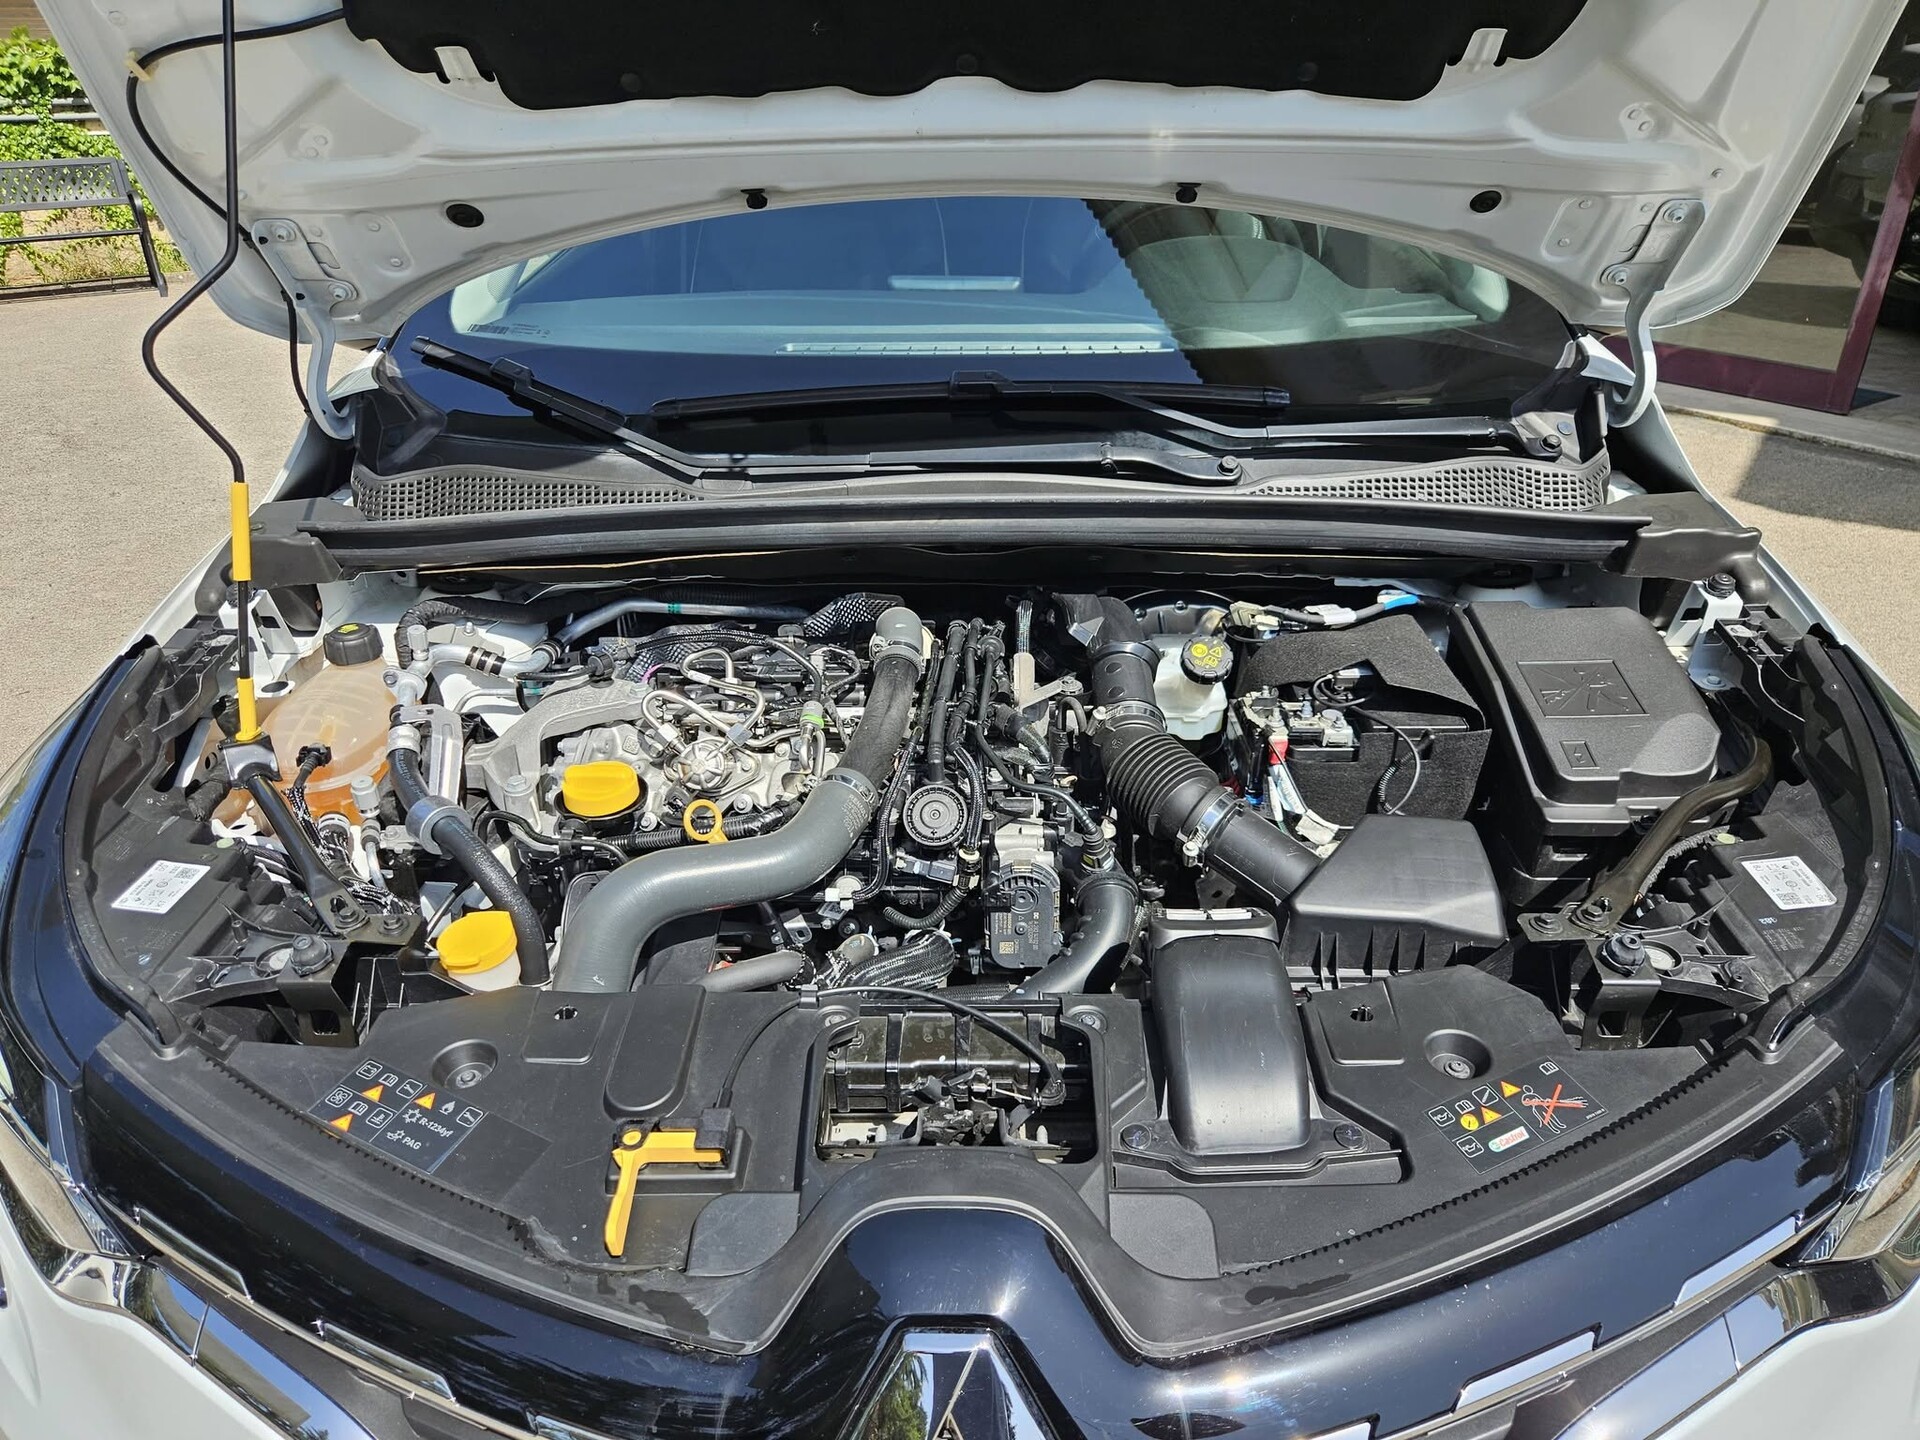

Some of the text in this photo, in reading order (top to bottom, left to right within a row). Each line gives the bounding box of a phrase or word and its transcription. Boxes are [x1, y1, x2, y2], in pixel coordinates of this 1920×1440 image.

[418, 1117, 454, 1138] R-1234yf
[402, 1136, 422, 1150] PAG
[1499, 1130, 1526, 1147] Castrol
